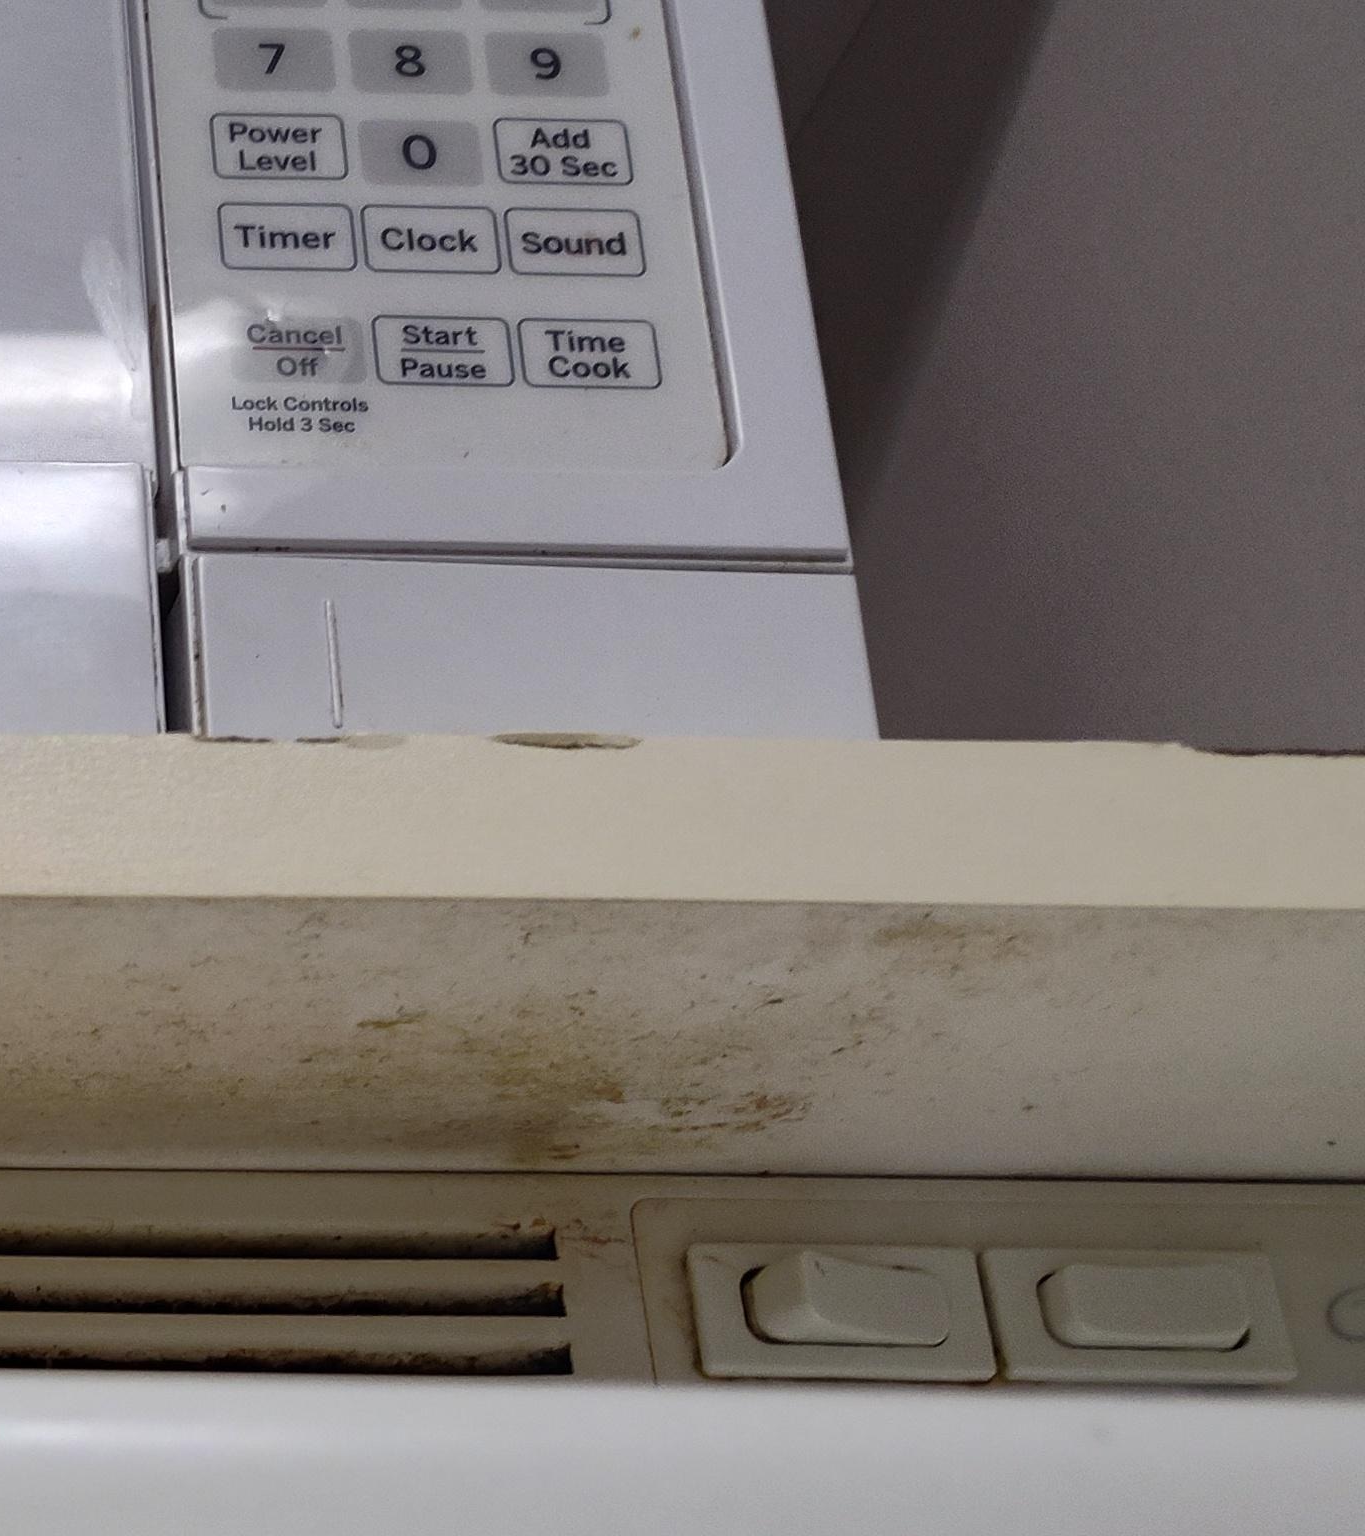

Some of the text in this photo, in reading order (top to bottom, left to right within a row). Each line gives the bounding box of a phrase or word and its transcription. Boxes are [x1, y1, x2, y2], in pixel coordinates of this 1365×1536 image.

[258, 42, 286, 75] 7
[394, 44, 426, 78] 8
[529, 47, 562, 81] 9
[228, 121, 323, 144] Power
[530, 127, 591, 150] Add
[238, 149, 317, 172] Level
[401, 133, 438, 171] 0
[510, 154, 618, 178] 30 Sec
[233, 224, 336, 250] Timer
[380, 227, 478, 253] Clock
[521, 231, 627, 257] Sound
[246, 323, 343, 345] Cancel
[402, 324, 478, 346] Start
[544, 329, 626, 354] Time
[276, 355, 320, 377] Off
[401, 357, 487, 380] Pause
[548, 355, 631, 379] Cook
[231, 395, 369, 413] Lock Controls
[248, 416, 356, 433] Hold 3 Sec
